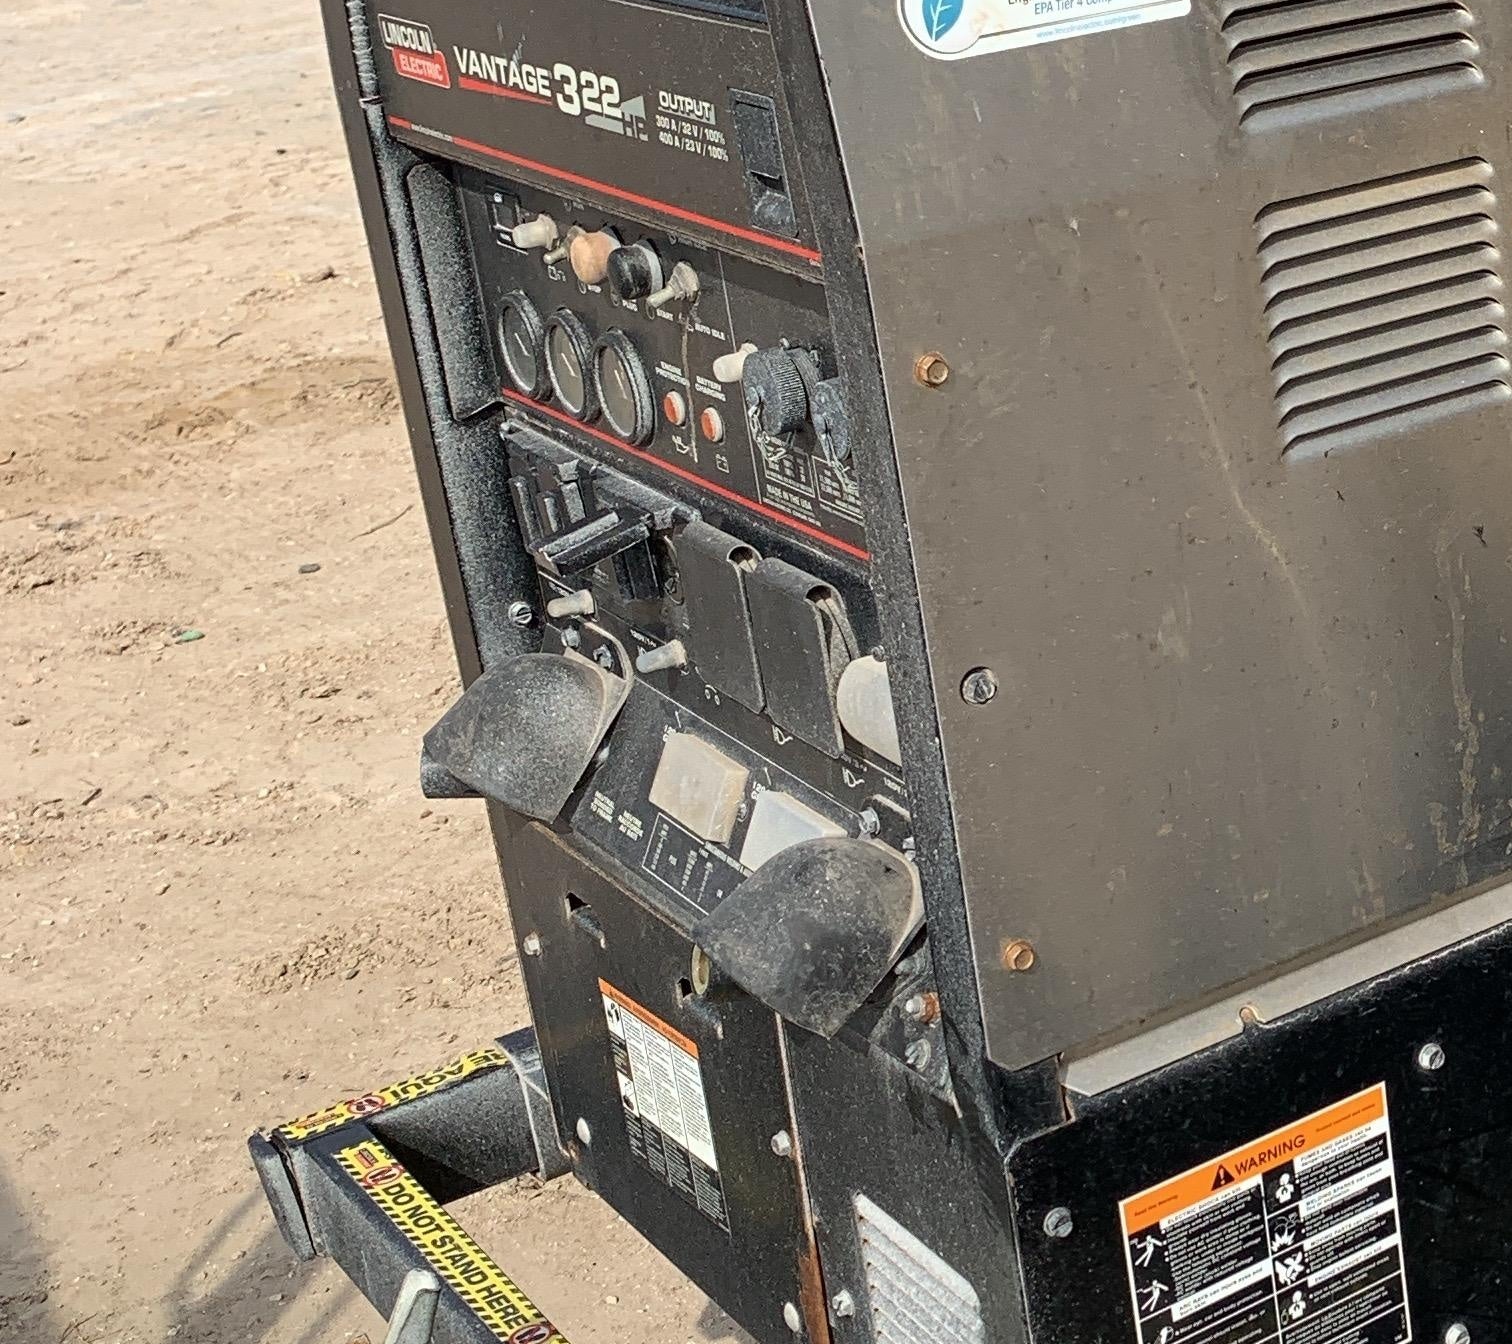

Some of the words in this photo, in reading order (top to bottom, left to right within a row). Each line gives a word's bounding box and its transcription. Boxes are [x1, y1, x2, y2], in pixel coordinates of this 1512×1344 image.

[1034, 0, 1054, 16] EPA
[381, 20, 433, 55] LINCOLN
[398, 53, 444, 82] ELECTRIC
[452, 45, 552, 98] VANTAGE
[552, 62, 623, 119] 322
[658, 90, 711, 121] OUTPUT
[1233, 1133, 1306, 1177] WARNING
[381, 1182, 415, 1206] DO
[402, 1205, 446, 1236] NOT
[430, 1234, 490, 1287] STAND
[475, 1283, 531, 1331] HERE
